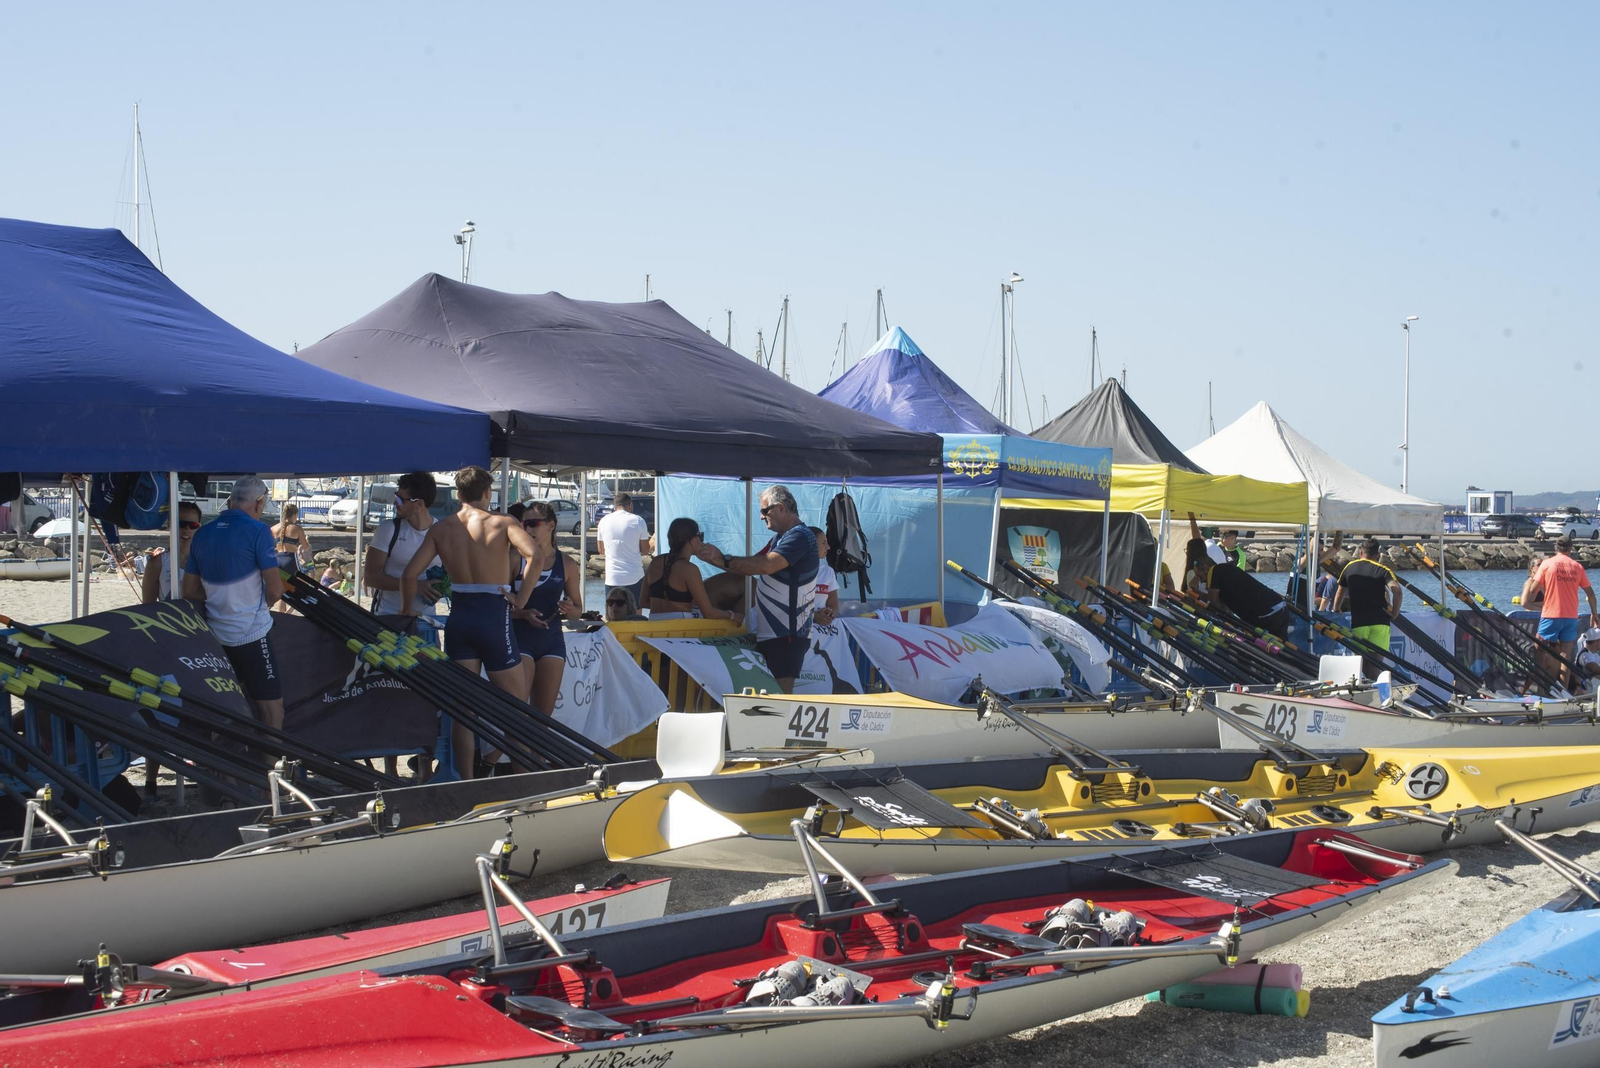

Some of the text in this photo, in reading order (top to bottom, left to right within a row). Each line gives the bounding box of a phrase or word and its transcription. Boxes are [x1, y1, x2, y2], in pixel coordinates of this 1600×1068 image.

[1006, 455, 1095, 481] CLUB NÁUTICO SANTA POLA
[351, 685, 364, 697] de
[862, 708, 892, 720] Diputación
[1323, 711, 1346, 724] Diputación
[788, 704, 830, 739] 424
[861, 721, 885, 732] de Cádiz
[984, 717, 1002, 732] Swift
[1265, 703, 1298, 742] 423
[1322, 725, 1341, 736] de Cádiz
[604, 1050, 675, 1068] Racing
